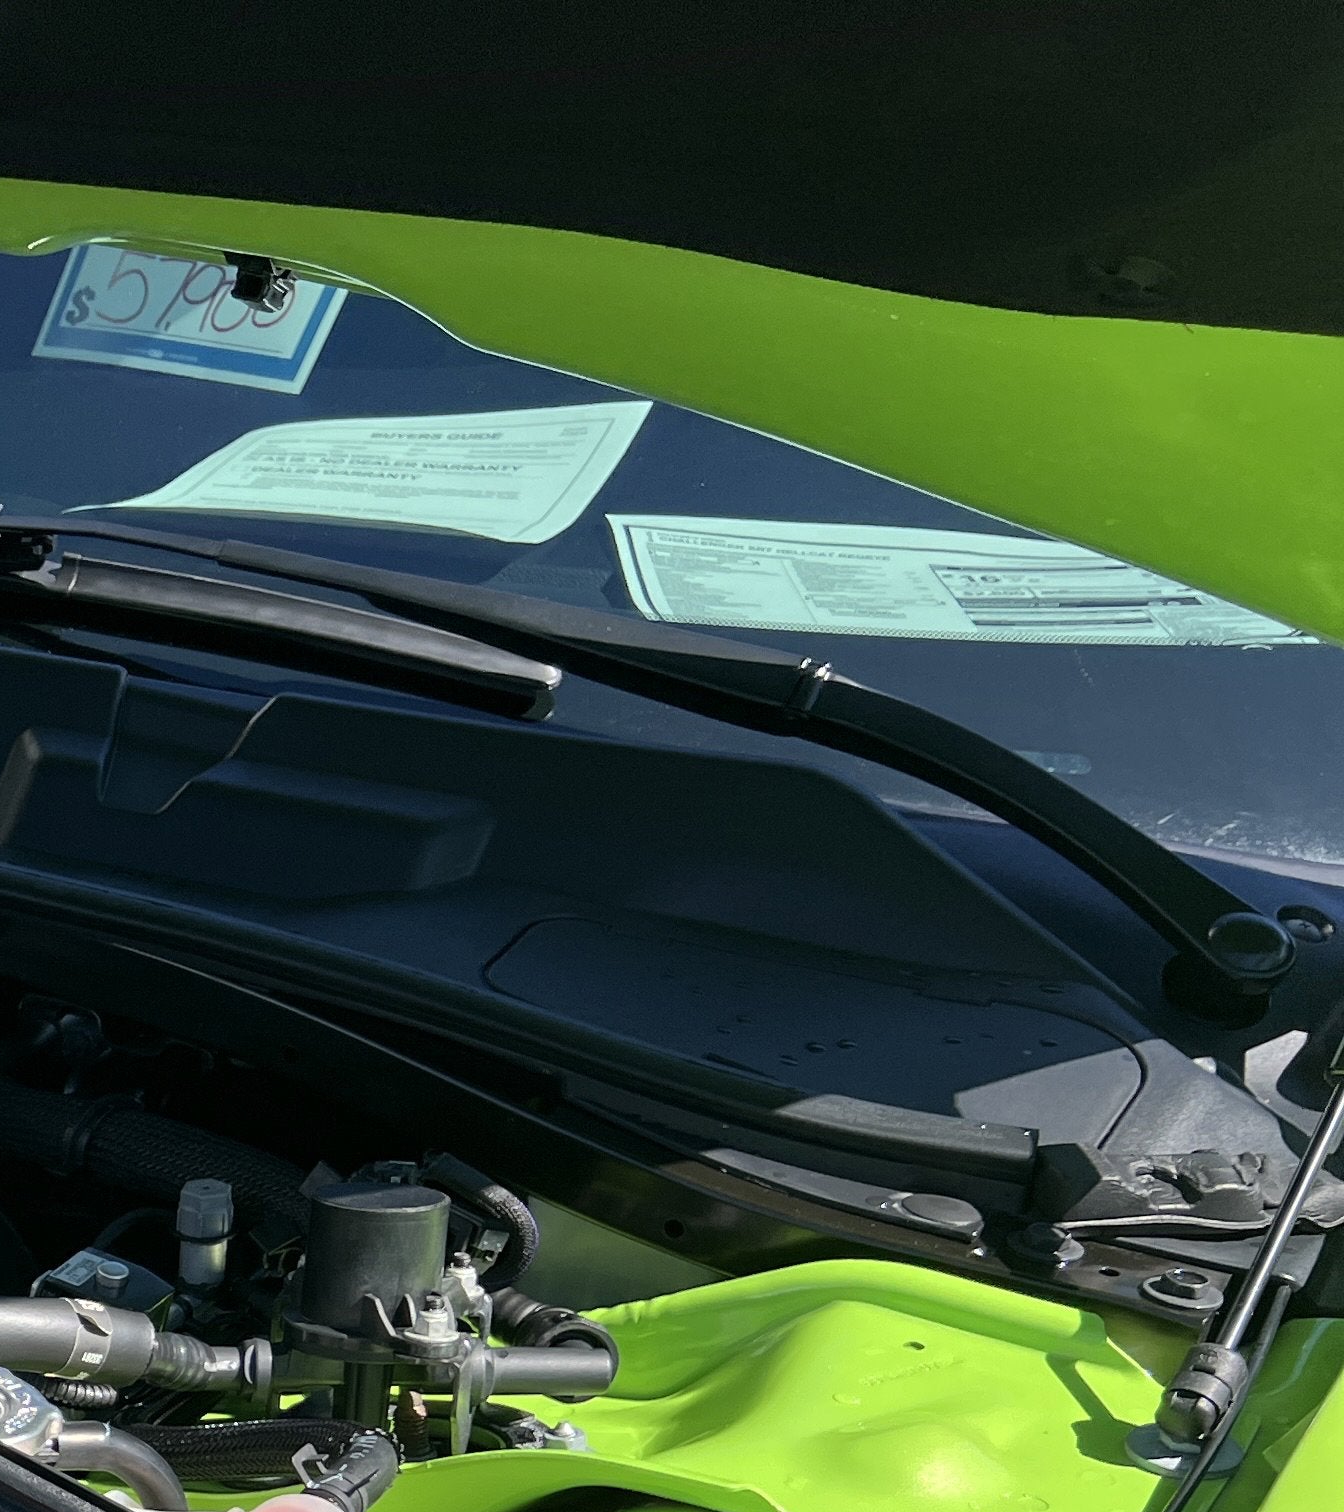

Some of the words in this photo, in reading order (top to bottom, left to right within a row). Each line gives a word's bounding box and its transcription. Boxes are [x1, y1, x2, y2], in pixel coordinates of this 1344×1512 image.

[370, 432, 442, 440] BUYERS
[446, 432, 503, 440] GUIDE
[422, 462, 523, 472] WARRANTY
[323, 469, 422, 480] WARRANTY
